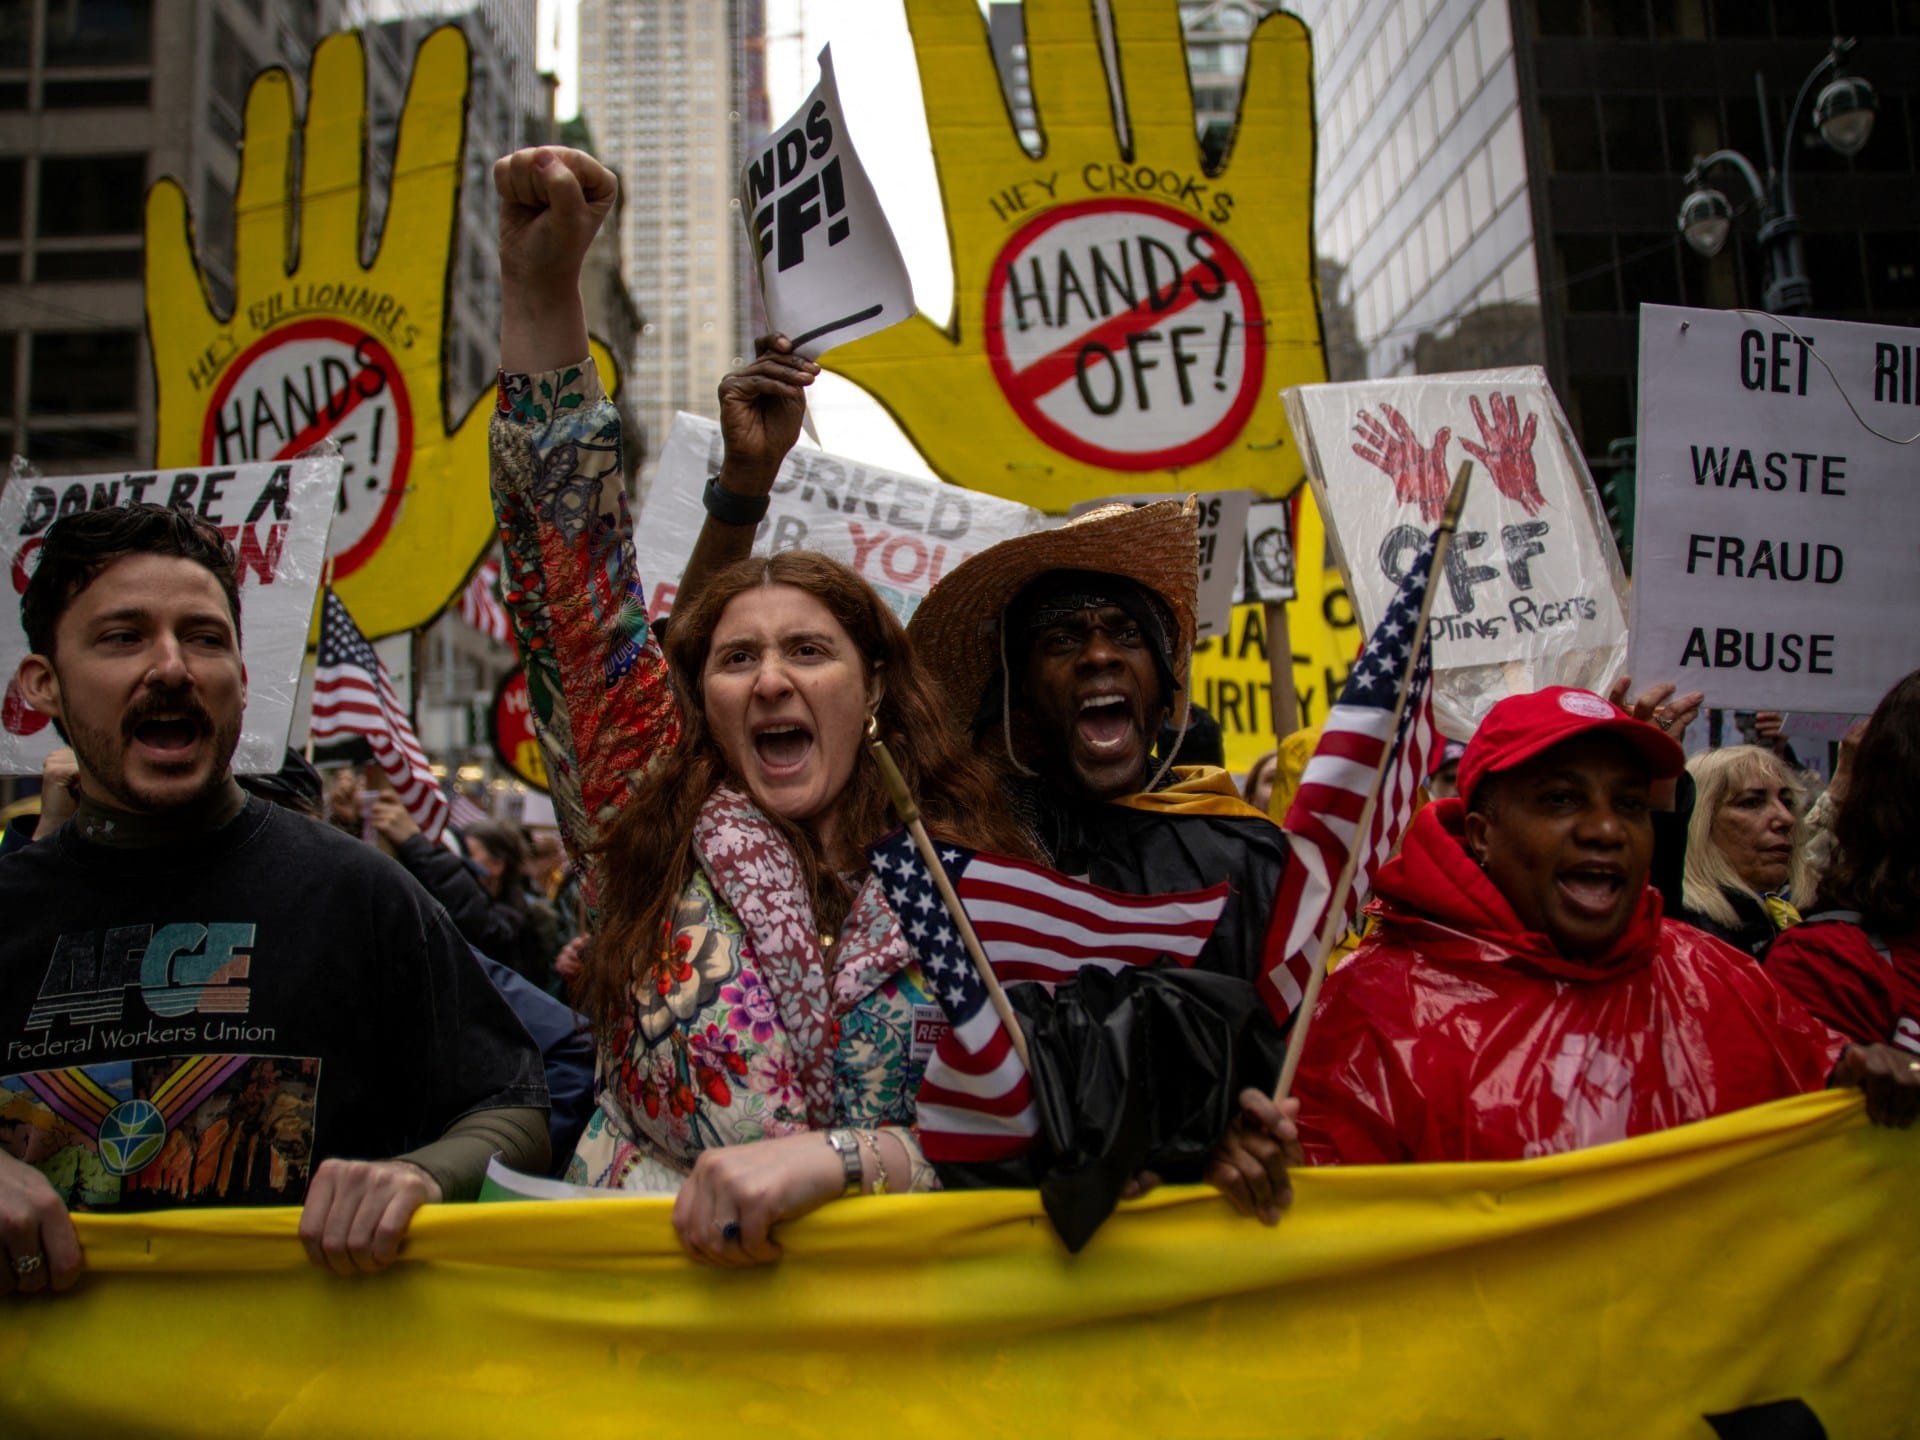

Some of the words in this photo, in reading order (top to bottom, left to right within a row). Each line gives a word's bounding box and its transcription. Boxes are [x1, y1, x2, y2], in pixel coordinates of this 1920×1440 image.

[989, 173, 1059, 222] HEY
[1083, 163, 1235, 223] CROOKS
[1007, 229, 1227, 332] HANDS
[187, 332, 237, 390] HEY
[1075, 311, 1234, 416] OFF!
[1740, 328, 1815, 397] GET
[1874, 341, 1920, 407] RI
[215, 335, 388, 466] HANDS
[168, 470, 236, 524] BE
[245, 464, 292, 523] A
[1690, 445, 1847, 496] WASTE
[1379, 521, 1549, 614] OFF
[1687, 533, 1844, 584] FRAUD
[1428, 613, 1507, 642] OTING
[1508, 596, 1597, 634] RIGHTS
[1679, 627, 1835, 674] ABUSE
[24, 922, 257, 1032] AFGE
[7, 1022, 95, 1061] Federal
[101, 1018, 197, 1050] Workers
[203, 1020, 276, 1042] Union
